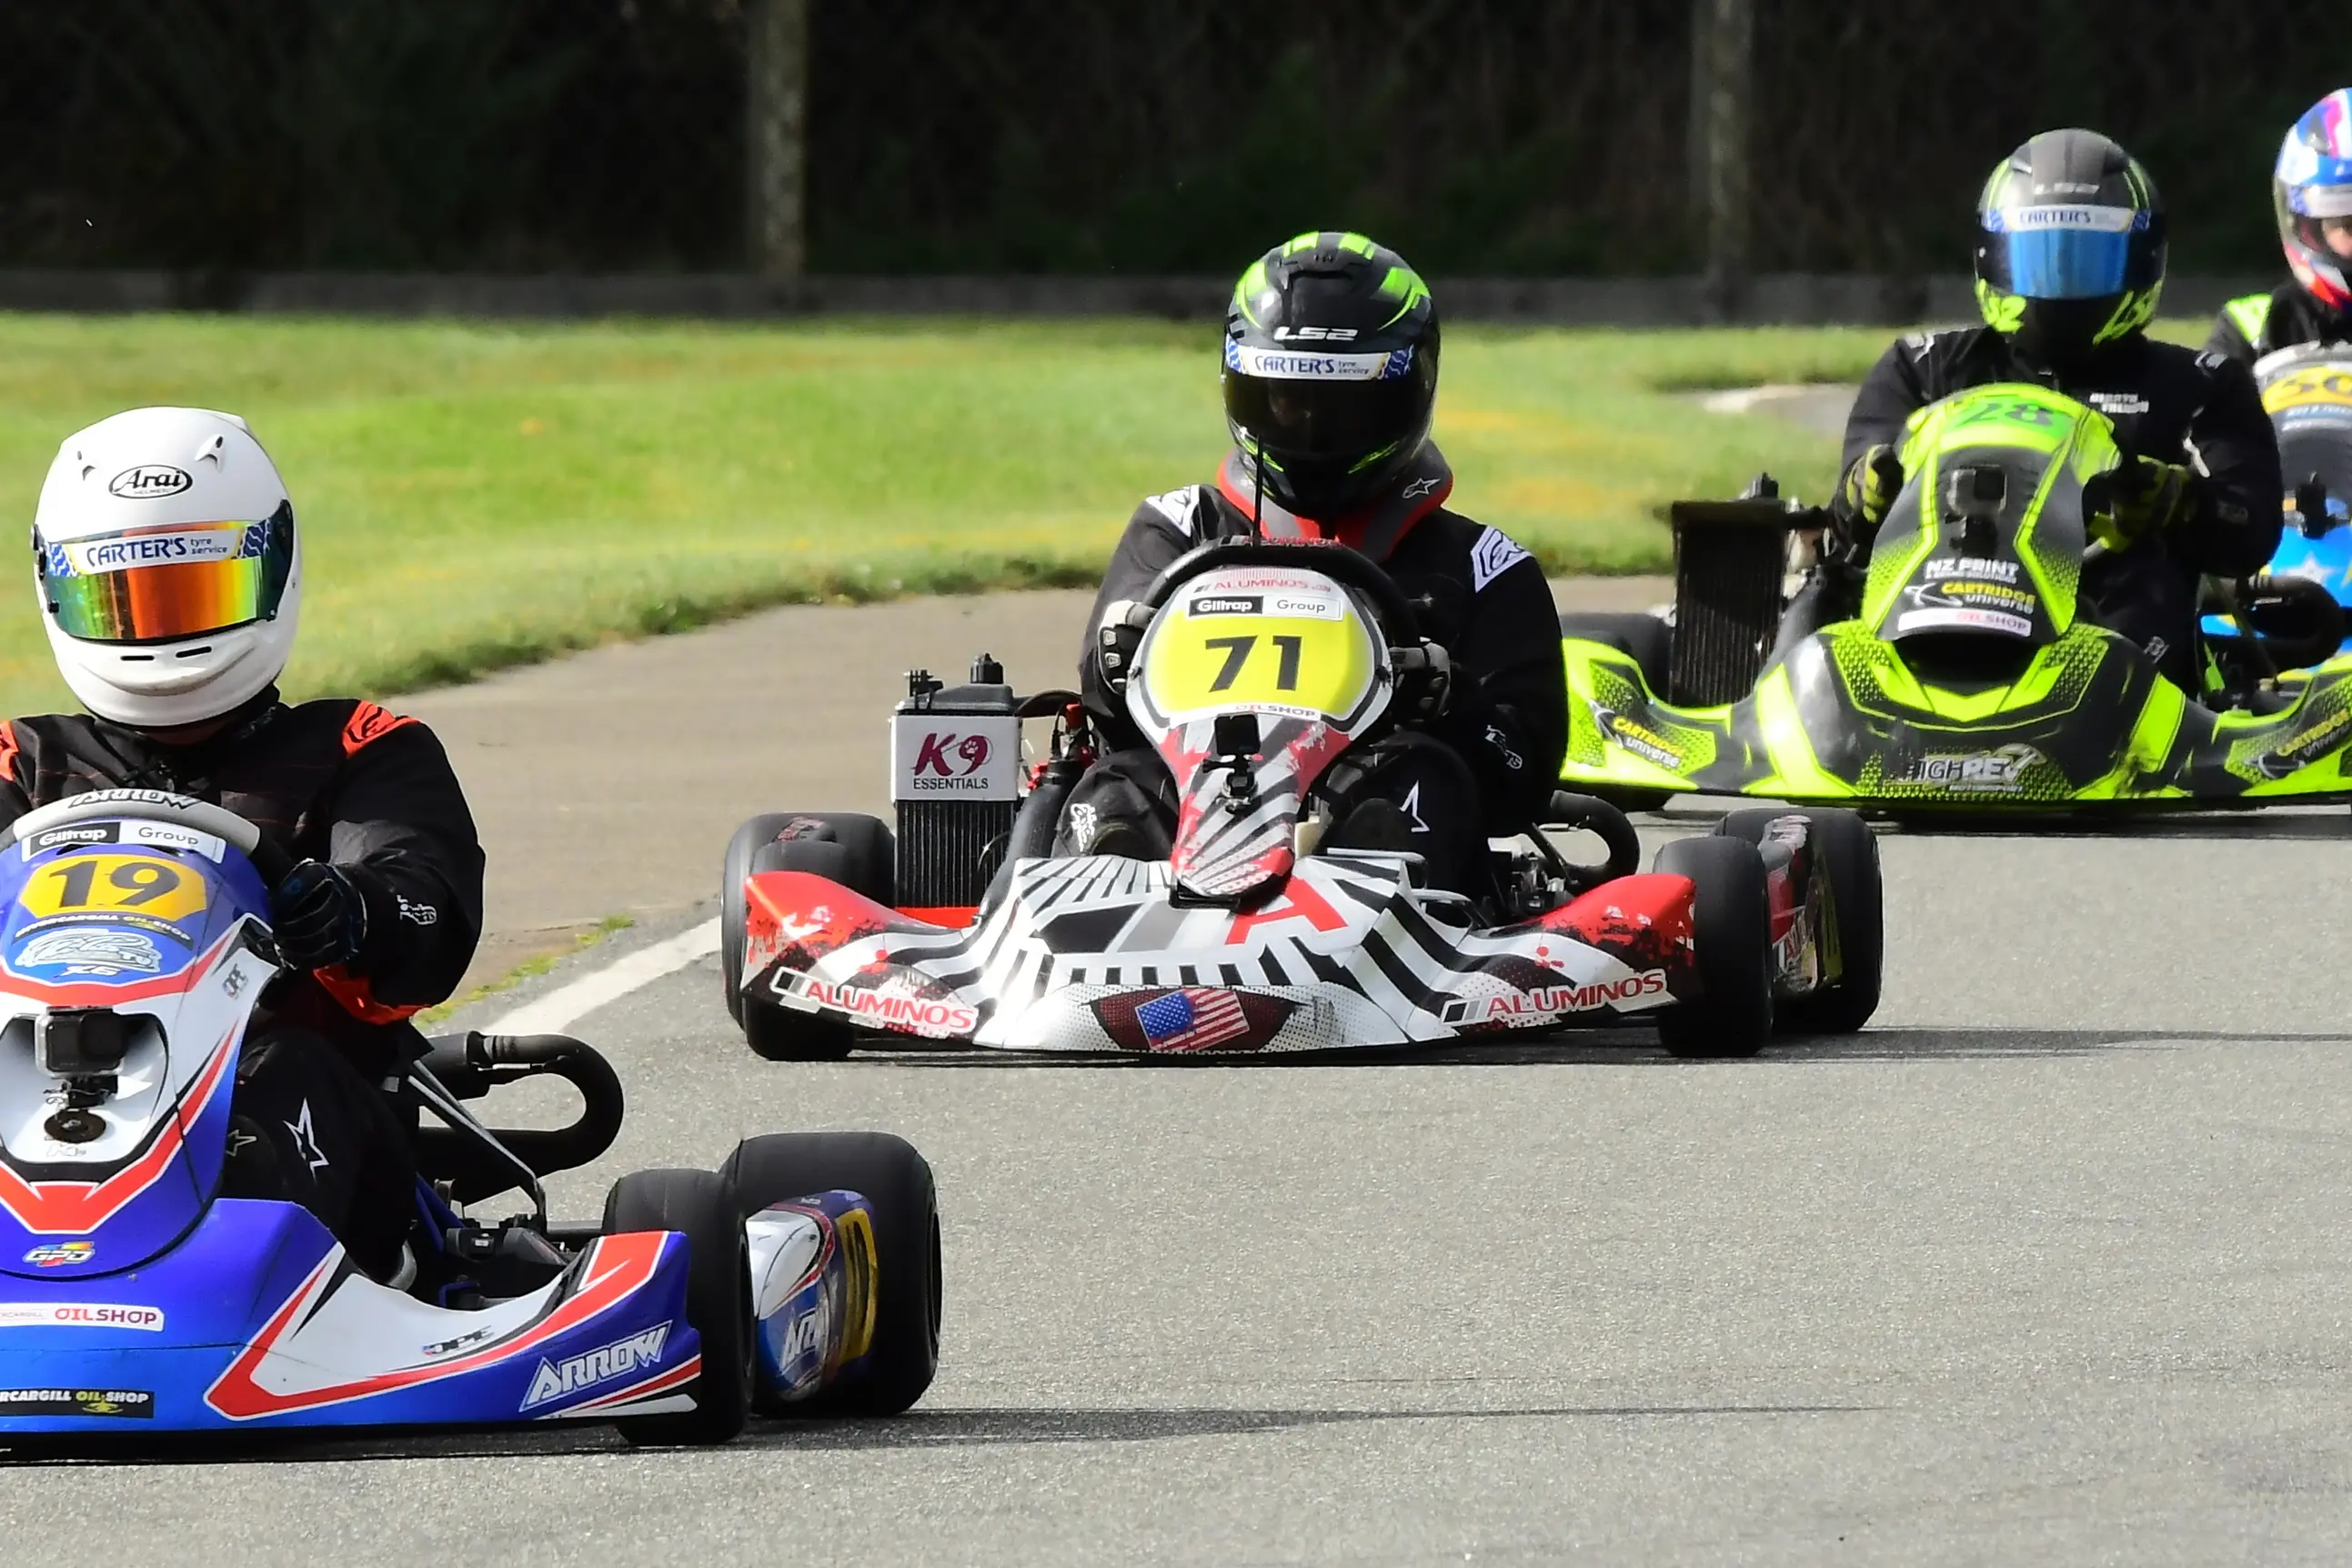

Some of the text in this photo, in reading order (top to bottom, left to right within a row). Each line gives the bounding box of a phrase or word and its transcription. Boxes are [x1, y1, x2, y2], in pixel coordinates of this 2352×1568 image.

[1274, 327, 1358, 341] LS2
[1255, 356, 1334, 375] CARTER'S
[114, 468, 183, 493] Arai
[86, 538, 186, 567] CARTER'S
[190, 538, 212, 548] tyre
[192, 546, 227, 555] service
[1926, 558, 2019, 576] NZ PRINT
[1214, 578, 1309, 590] ALUMINOS
[1197, 599, 1326, 613] Giltrap Group
[1205, 635, 1302, 692] 71
[913, 732, 991, 777] K9
[913, 778, 989, 789] ESSENTIALS
[68, 789, 203, 809] ARROW
[39, 827, 199, 847] Giltrap Group
[49, 860, 180, 908] 19
[1487, 972, 1664, 1018] ALUMINOS
[806, 981, 974, 1029] ALUMINOS
[55, 1308, 157, 1324] OILSHOP
[521, 1322, 671, 1411] ARROW
[75, 1391, 101, 1402] OIL
[106, 1392, 149, 1403] SHOP
